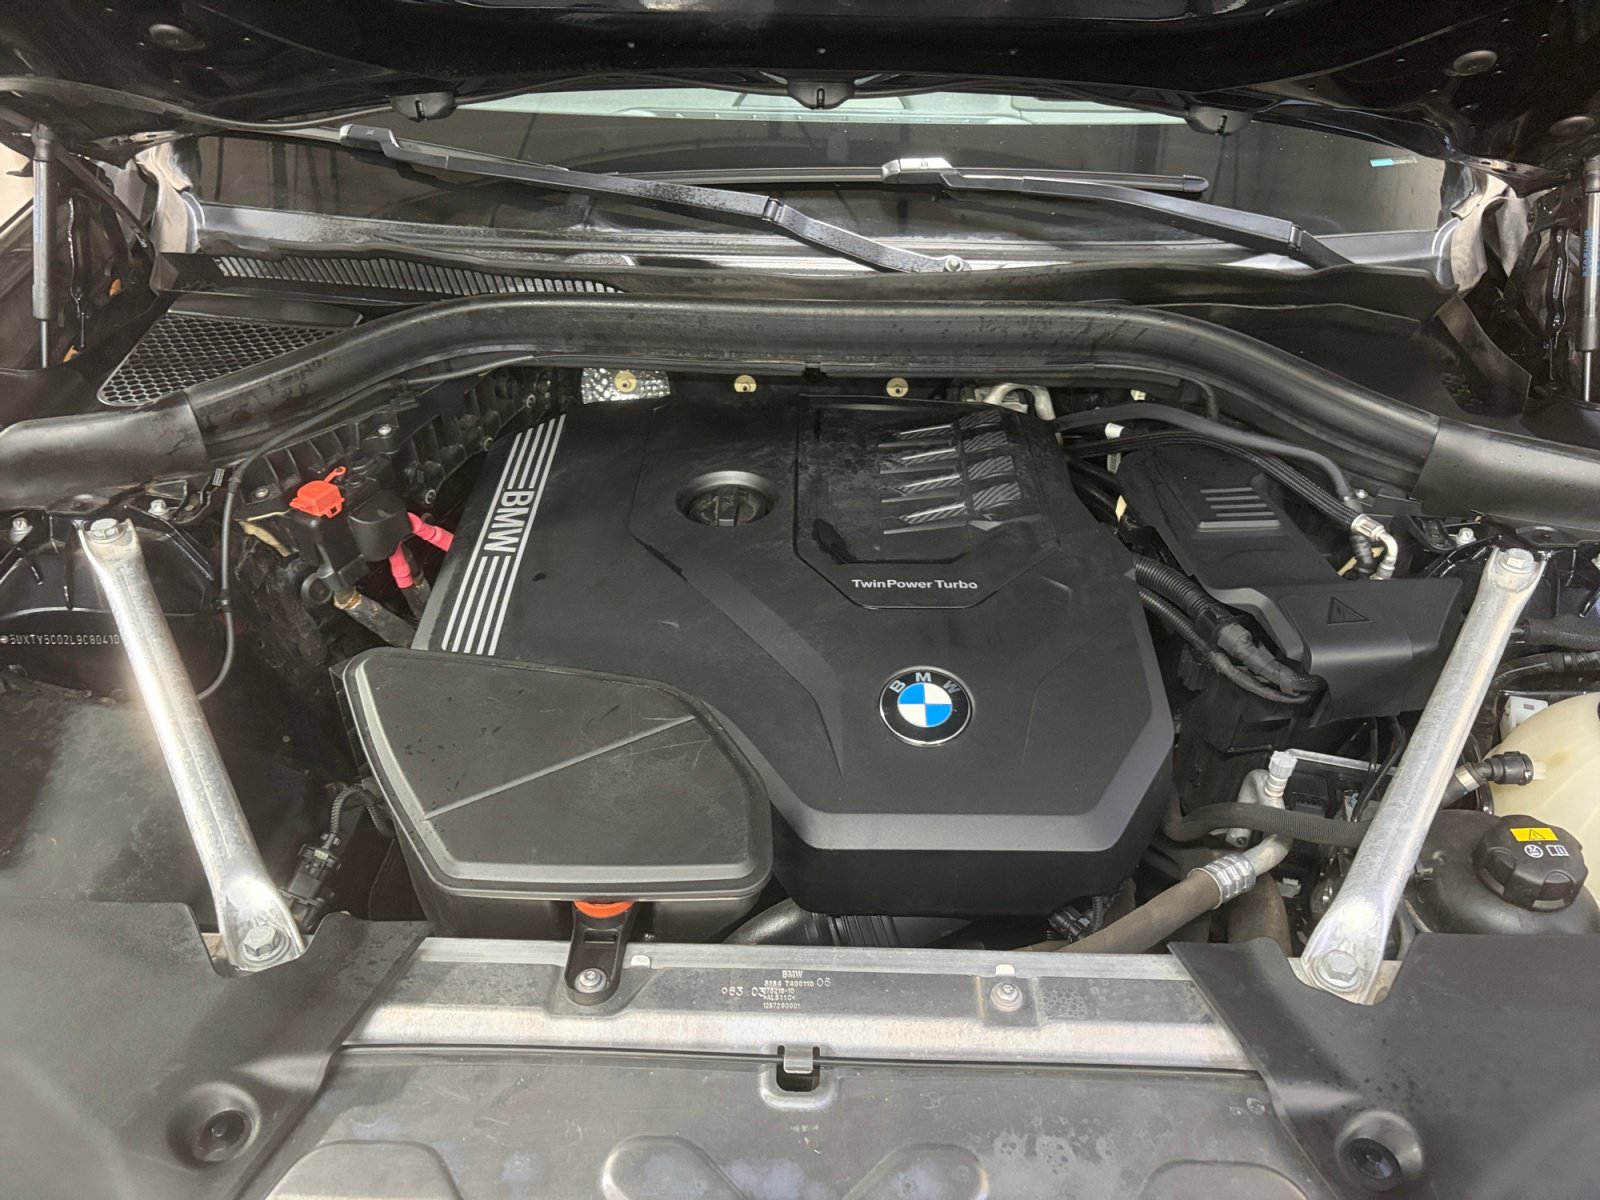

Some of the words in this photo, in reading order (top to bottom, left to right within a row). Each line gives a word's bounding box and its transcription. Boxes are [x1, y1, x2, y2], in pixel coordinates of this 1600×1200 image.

[484, 491, 535, 553] BMW
[851, 579, 932, 589] TwinPower
[934, 579, 978, 589] Turbo
[889, 672, 961, 694] BMW
[782, 970, 803, 979] BMW
